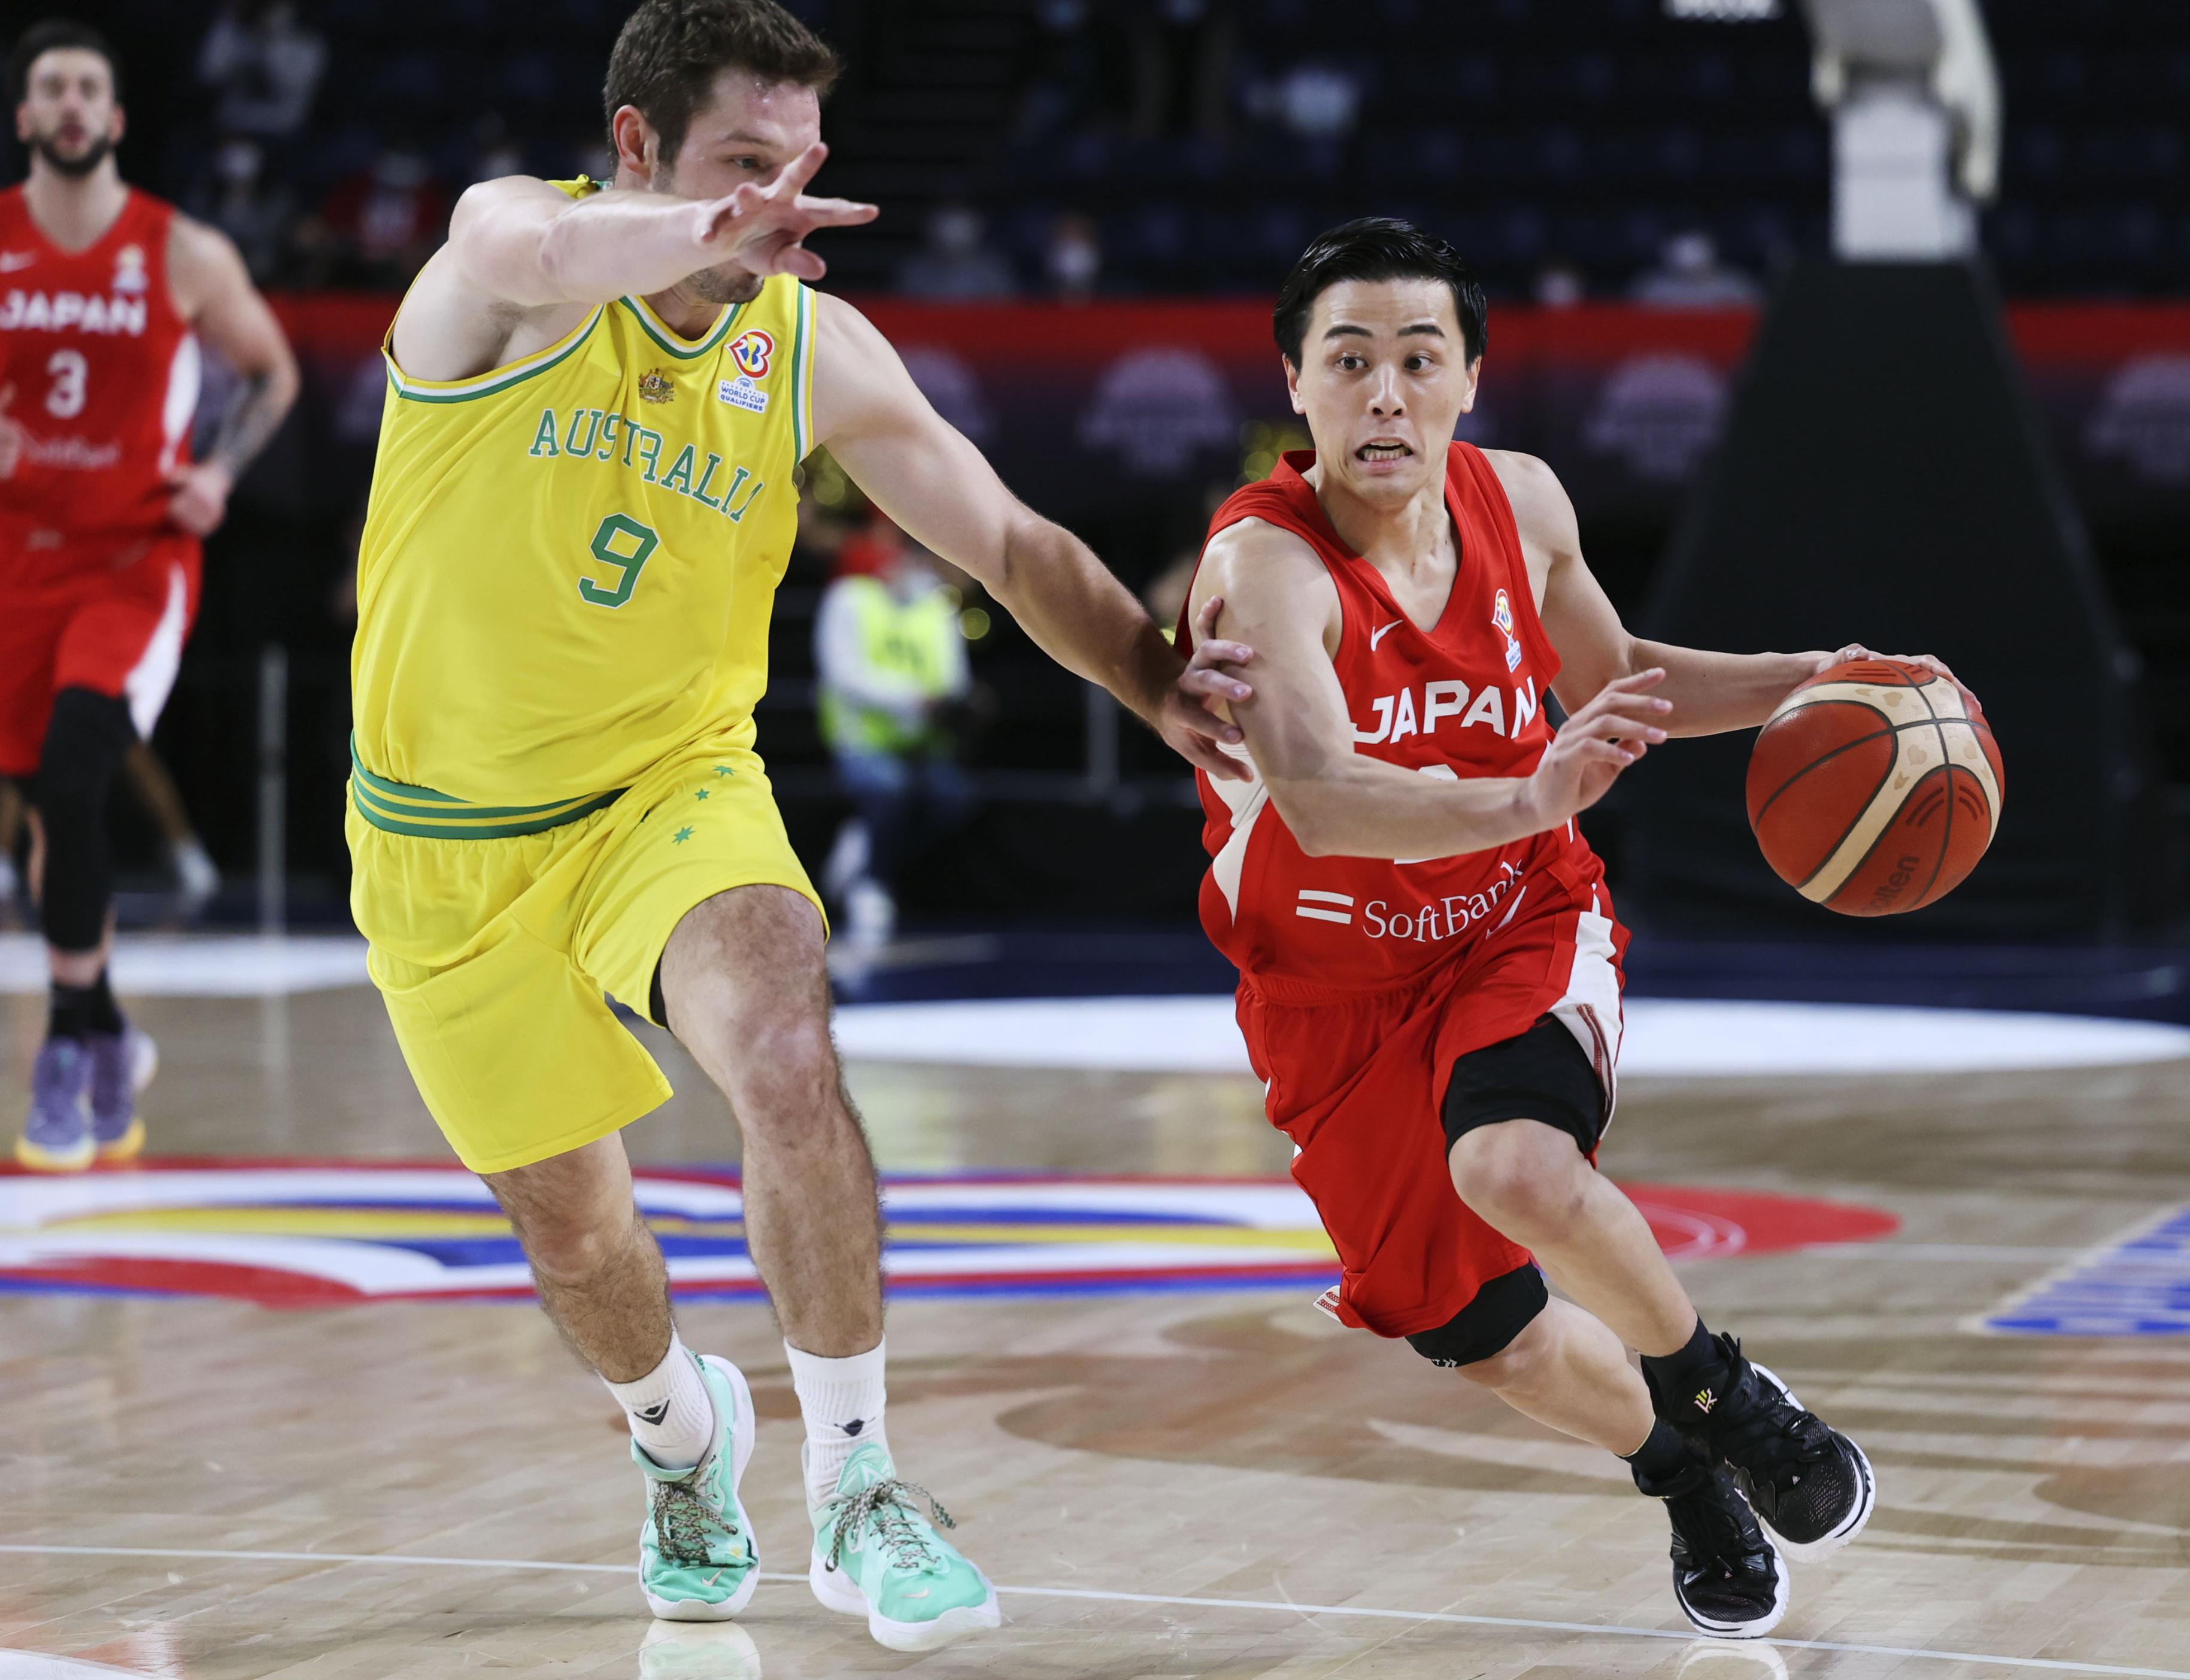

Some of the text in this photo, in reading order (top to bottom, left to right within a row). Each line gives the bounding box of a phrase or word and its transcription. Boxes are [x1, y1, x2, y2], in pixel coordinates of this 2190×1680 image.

[0, 289, 147, 337] JAPAN
[45, 347, 88, 419] 3
[720, 394, 763, 411] QUALIFIERS
[721, 386, 765, 404] WORLD CUP
[577, 513, 660, 609] 9
[1351, 676, 1537, 744] JAPAN
